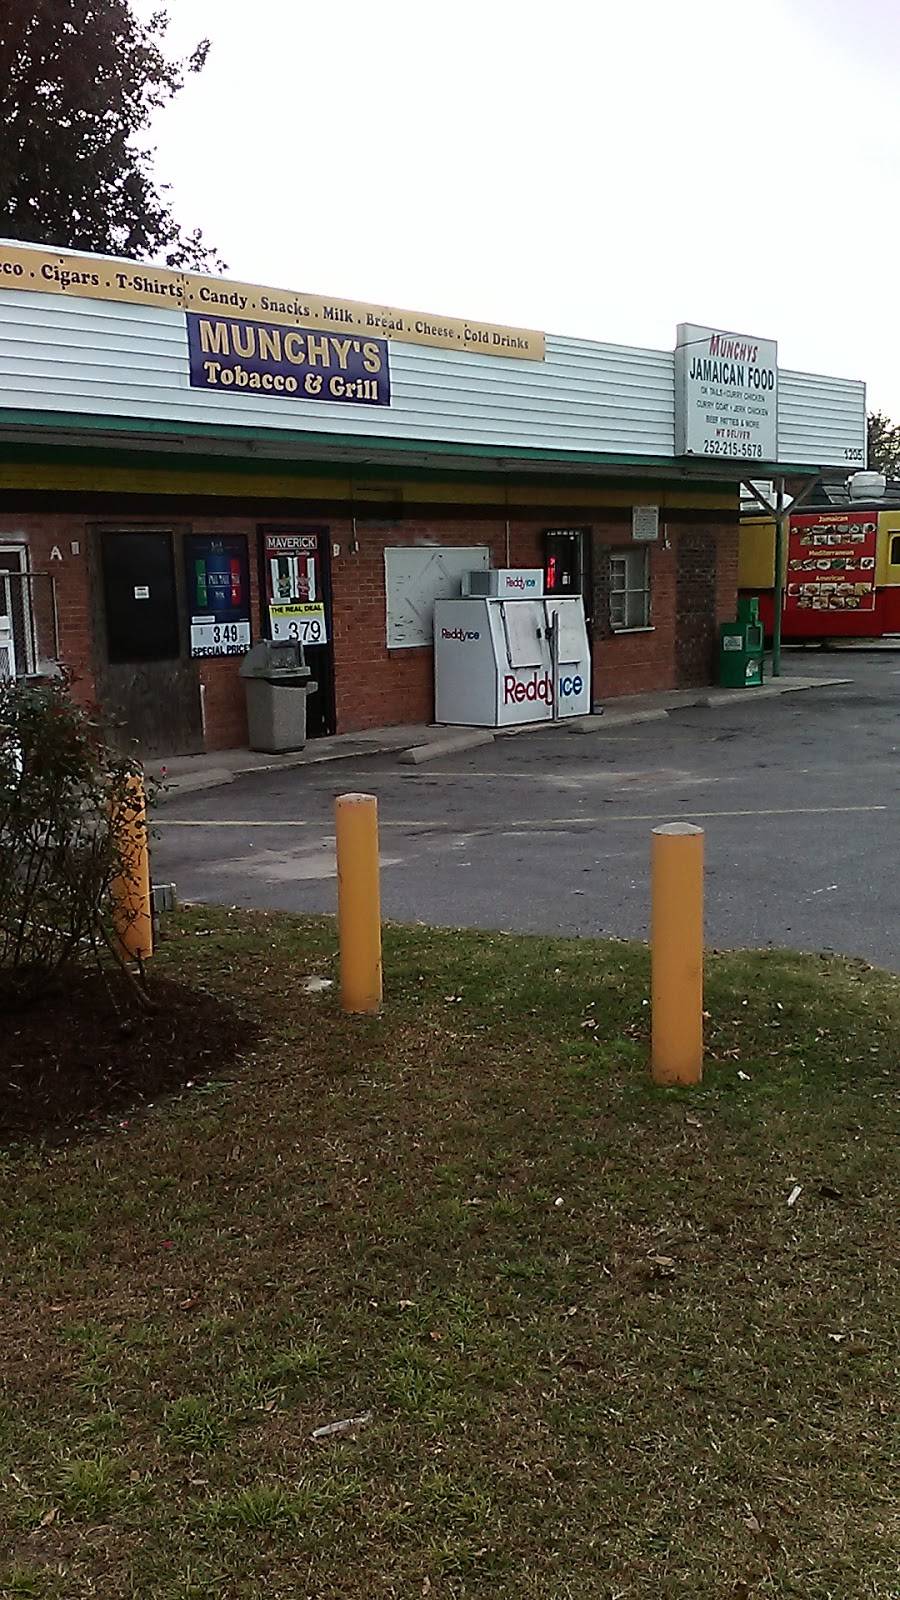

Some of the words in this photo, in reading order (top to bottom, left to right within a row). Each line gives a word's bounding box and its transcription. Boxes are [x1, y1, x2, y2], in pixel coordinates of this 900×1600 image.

[0, 263, 23, 276] co
[41, 264, 99, 286] Cigars
[116, 274, 183, 298] T-Shirts
[200, 287, 248, 309] Candy
[261, 297, 310, 317] Snacks
[323, 306, 354, 323] Milk
[366, 313, 403, 331] Bread
[415, 321, 454, 338] Cheese
[464, 328, 489, 344] Cold
[493, 333, 529, 350] Drinks
[199, 319, 382, 374] MUNCHY'S
[204, 360, 298, 392] Tobacco
[304, 373, 323, 394] &
[329, 375, 378, 400] Grill
[689, 357, 744, 387] JAMAICAN
[748, 367, 775, 391] FOOD
[715, 428, 725, 438] WE
[726, 429, 751, 440] DELIVER
[704, 440, 762, 457] 252-215-5678
[50, 545, 63, 561] A
[268, 537, 316, 548] MAVERICK
[192, 645, 225, 657] SPECIAL
[504, 671, 554, 706] Reddy
